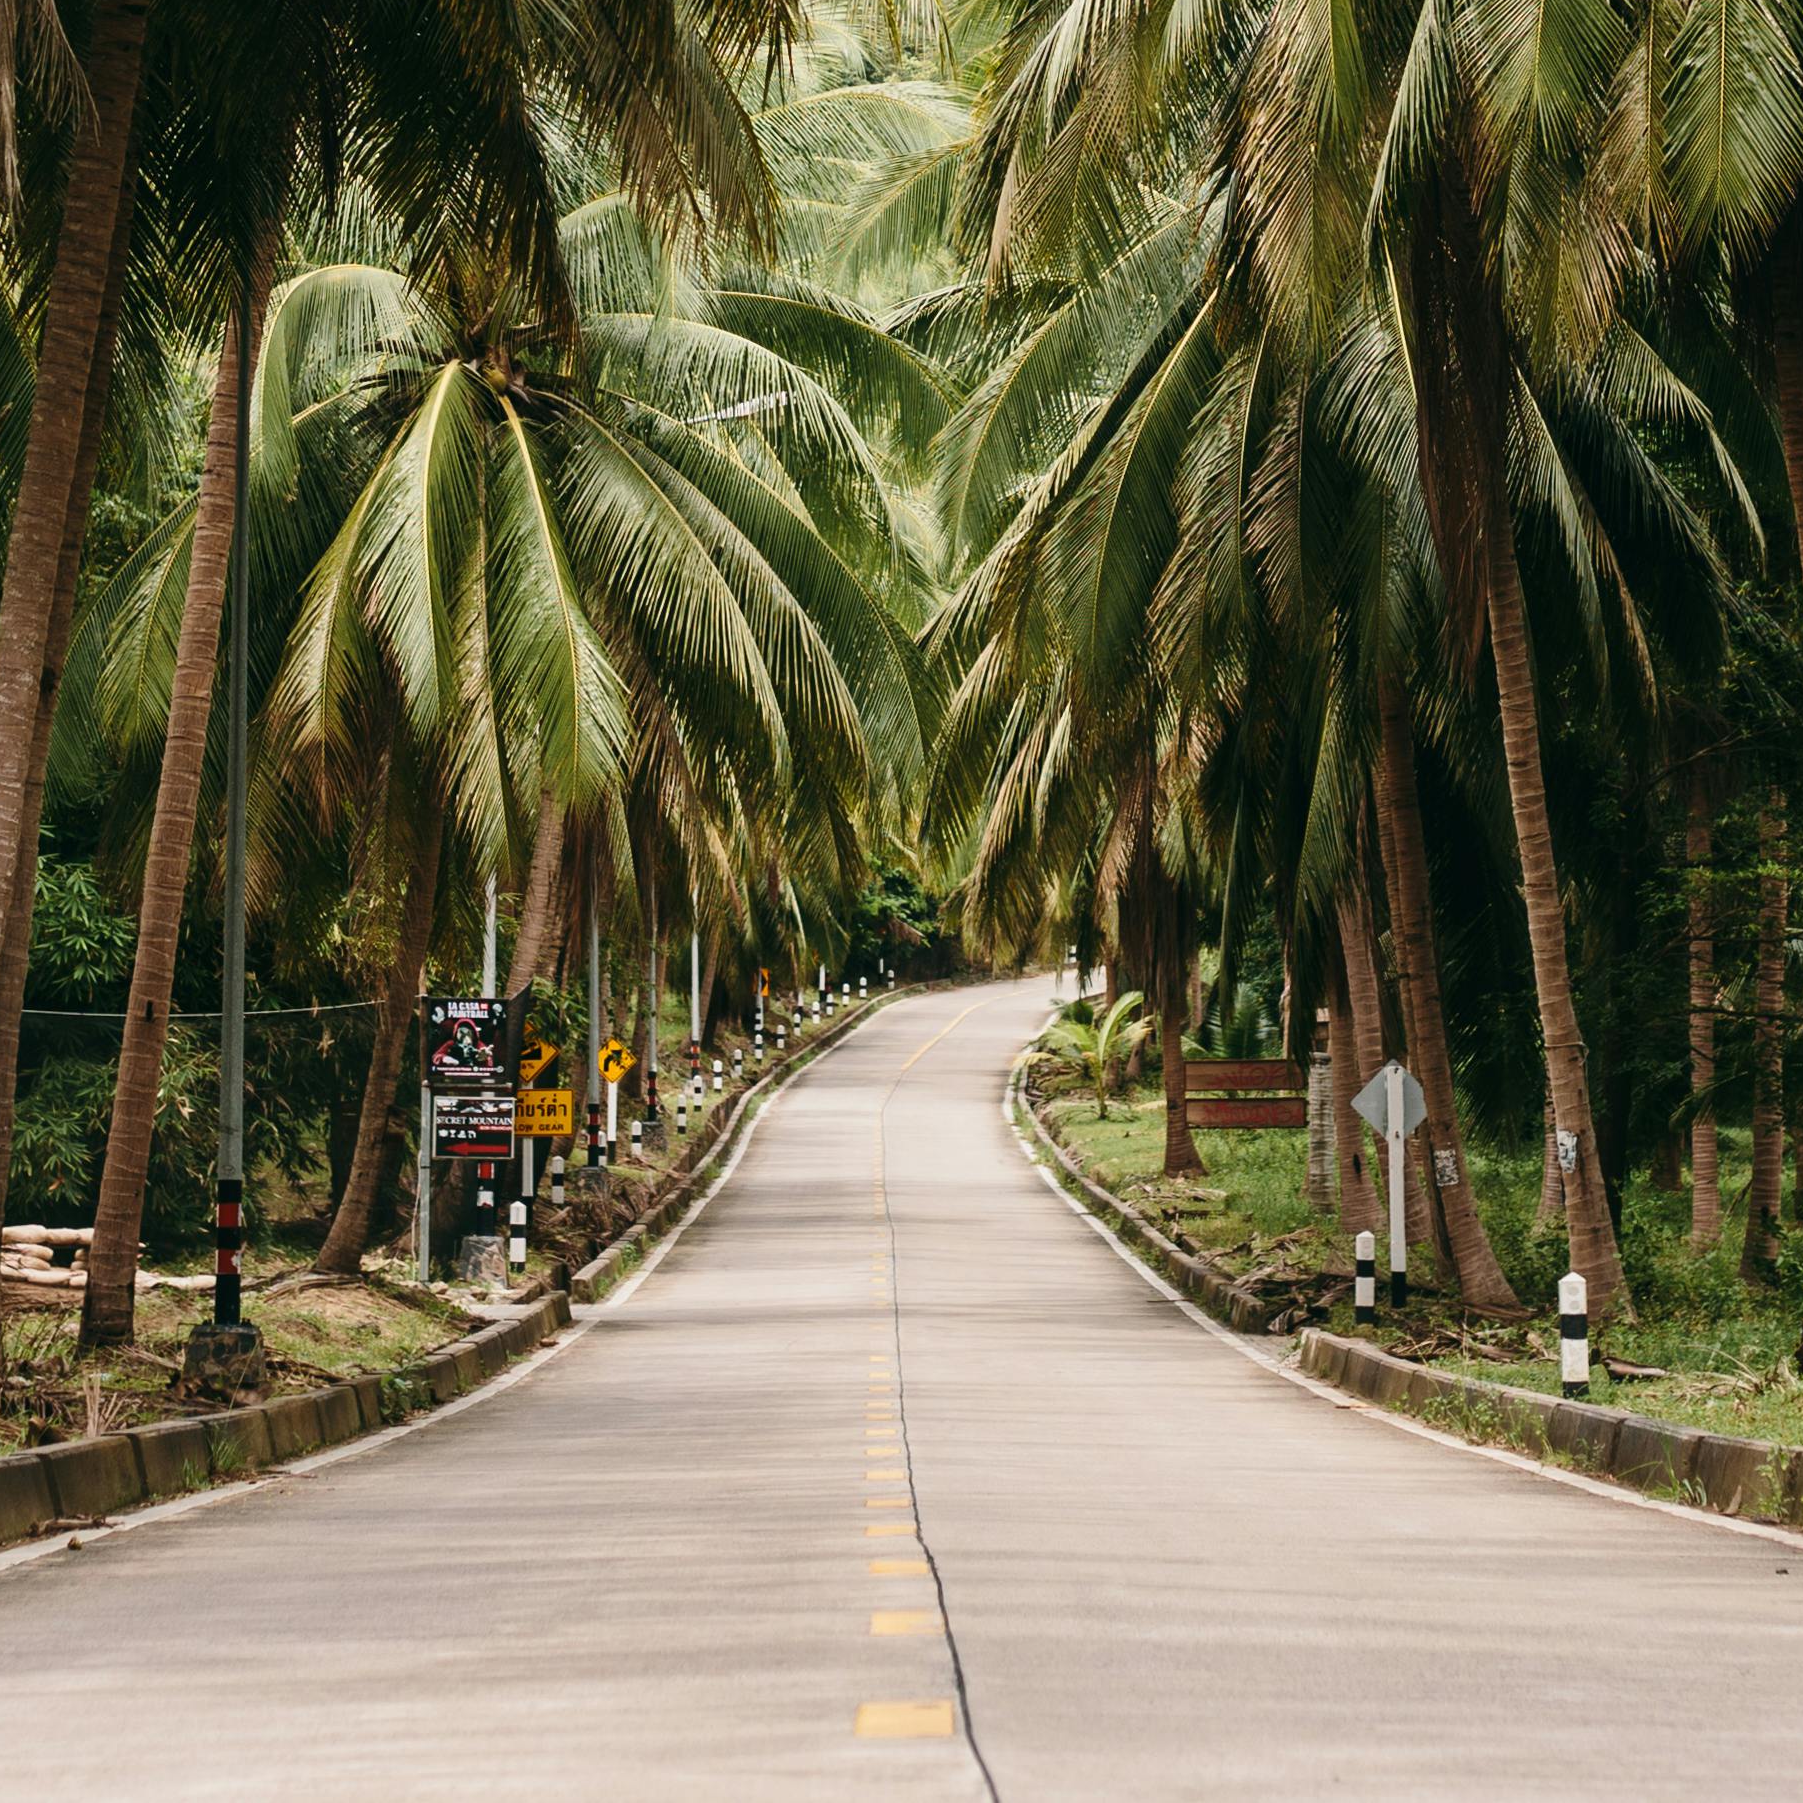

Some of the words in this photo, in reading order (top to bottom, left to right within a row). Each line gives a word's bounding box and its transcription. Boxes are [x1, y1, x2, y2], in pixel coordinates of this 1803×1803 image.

[447, 1001, 458, 1011] LA
[459, 1001, 480, 1011] CASA
[447, 1010, 490, 1019] PAINTBALL
[436, 1116, 467, 1125] SECRET
[468, 1116, 513, 1125] MOUNTAIN
[538, 1123, 565, 1132] GEAR
